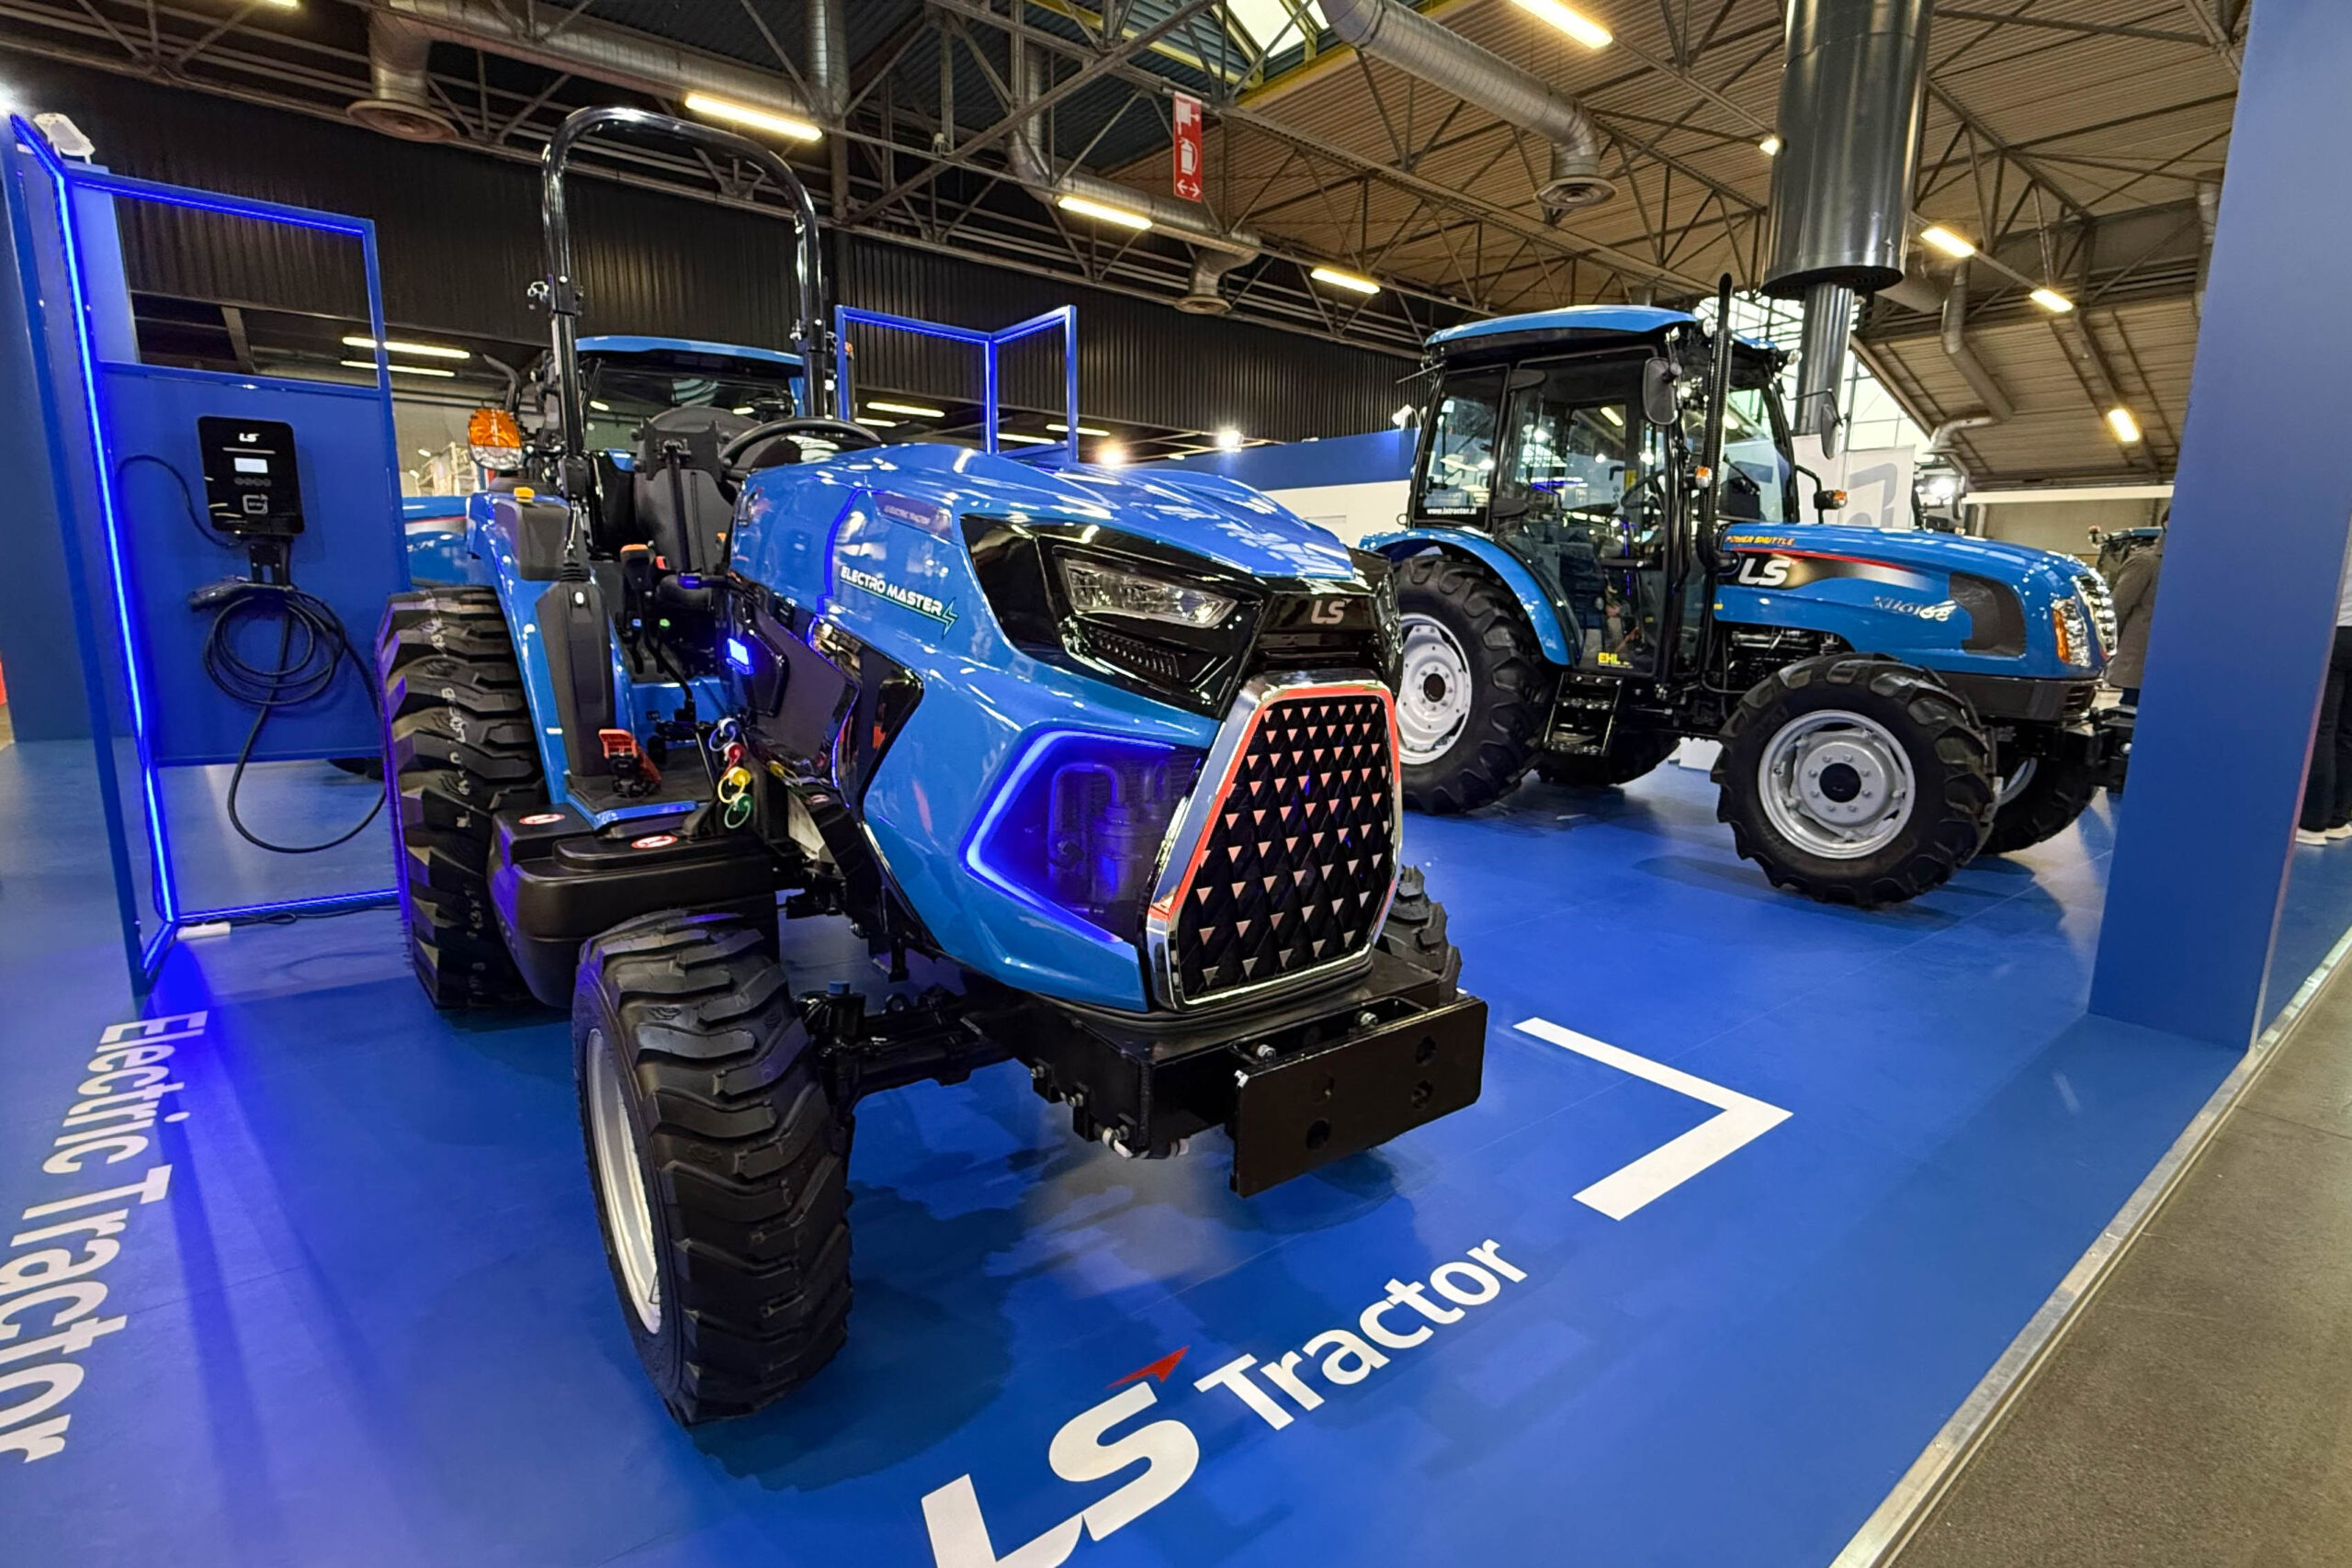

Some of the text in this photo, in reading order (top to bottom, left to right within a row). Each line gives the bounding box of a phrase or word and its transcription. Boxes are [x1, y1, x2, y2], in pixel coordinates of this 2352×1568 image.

[239, 433, 257, 442] LS
[841, 566, 943, 615] ELECTRO MASTER
[1738, 558, 1790, 586] LS
[1311, 599, 1346, 624] LS
[42, 1010, 208, 1175] Electric
[922, 1238, 1528, 1568] LS Tractor
